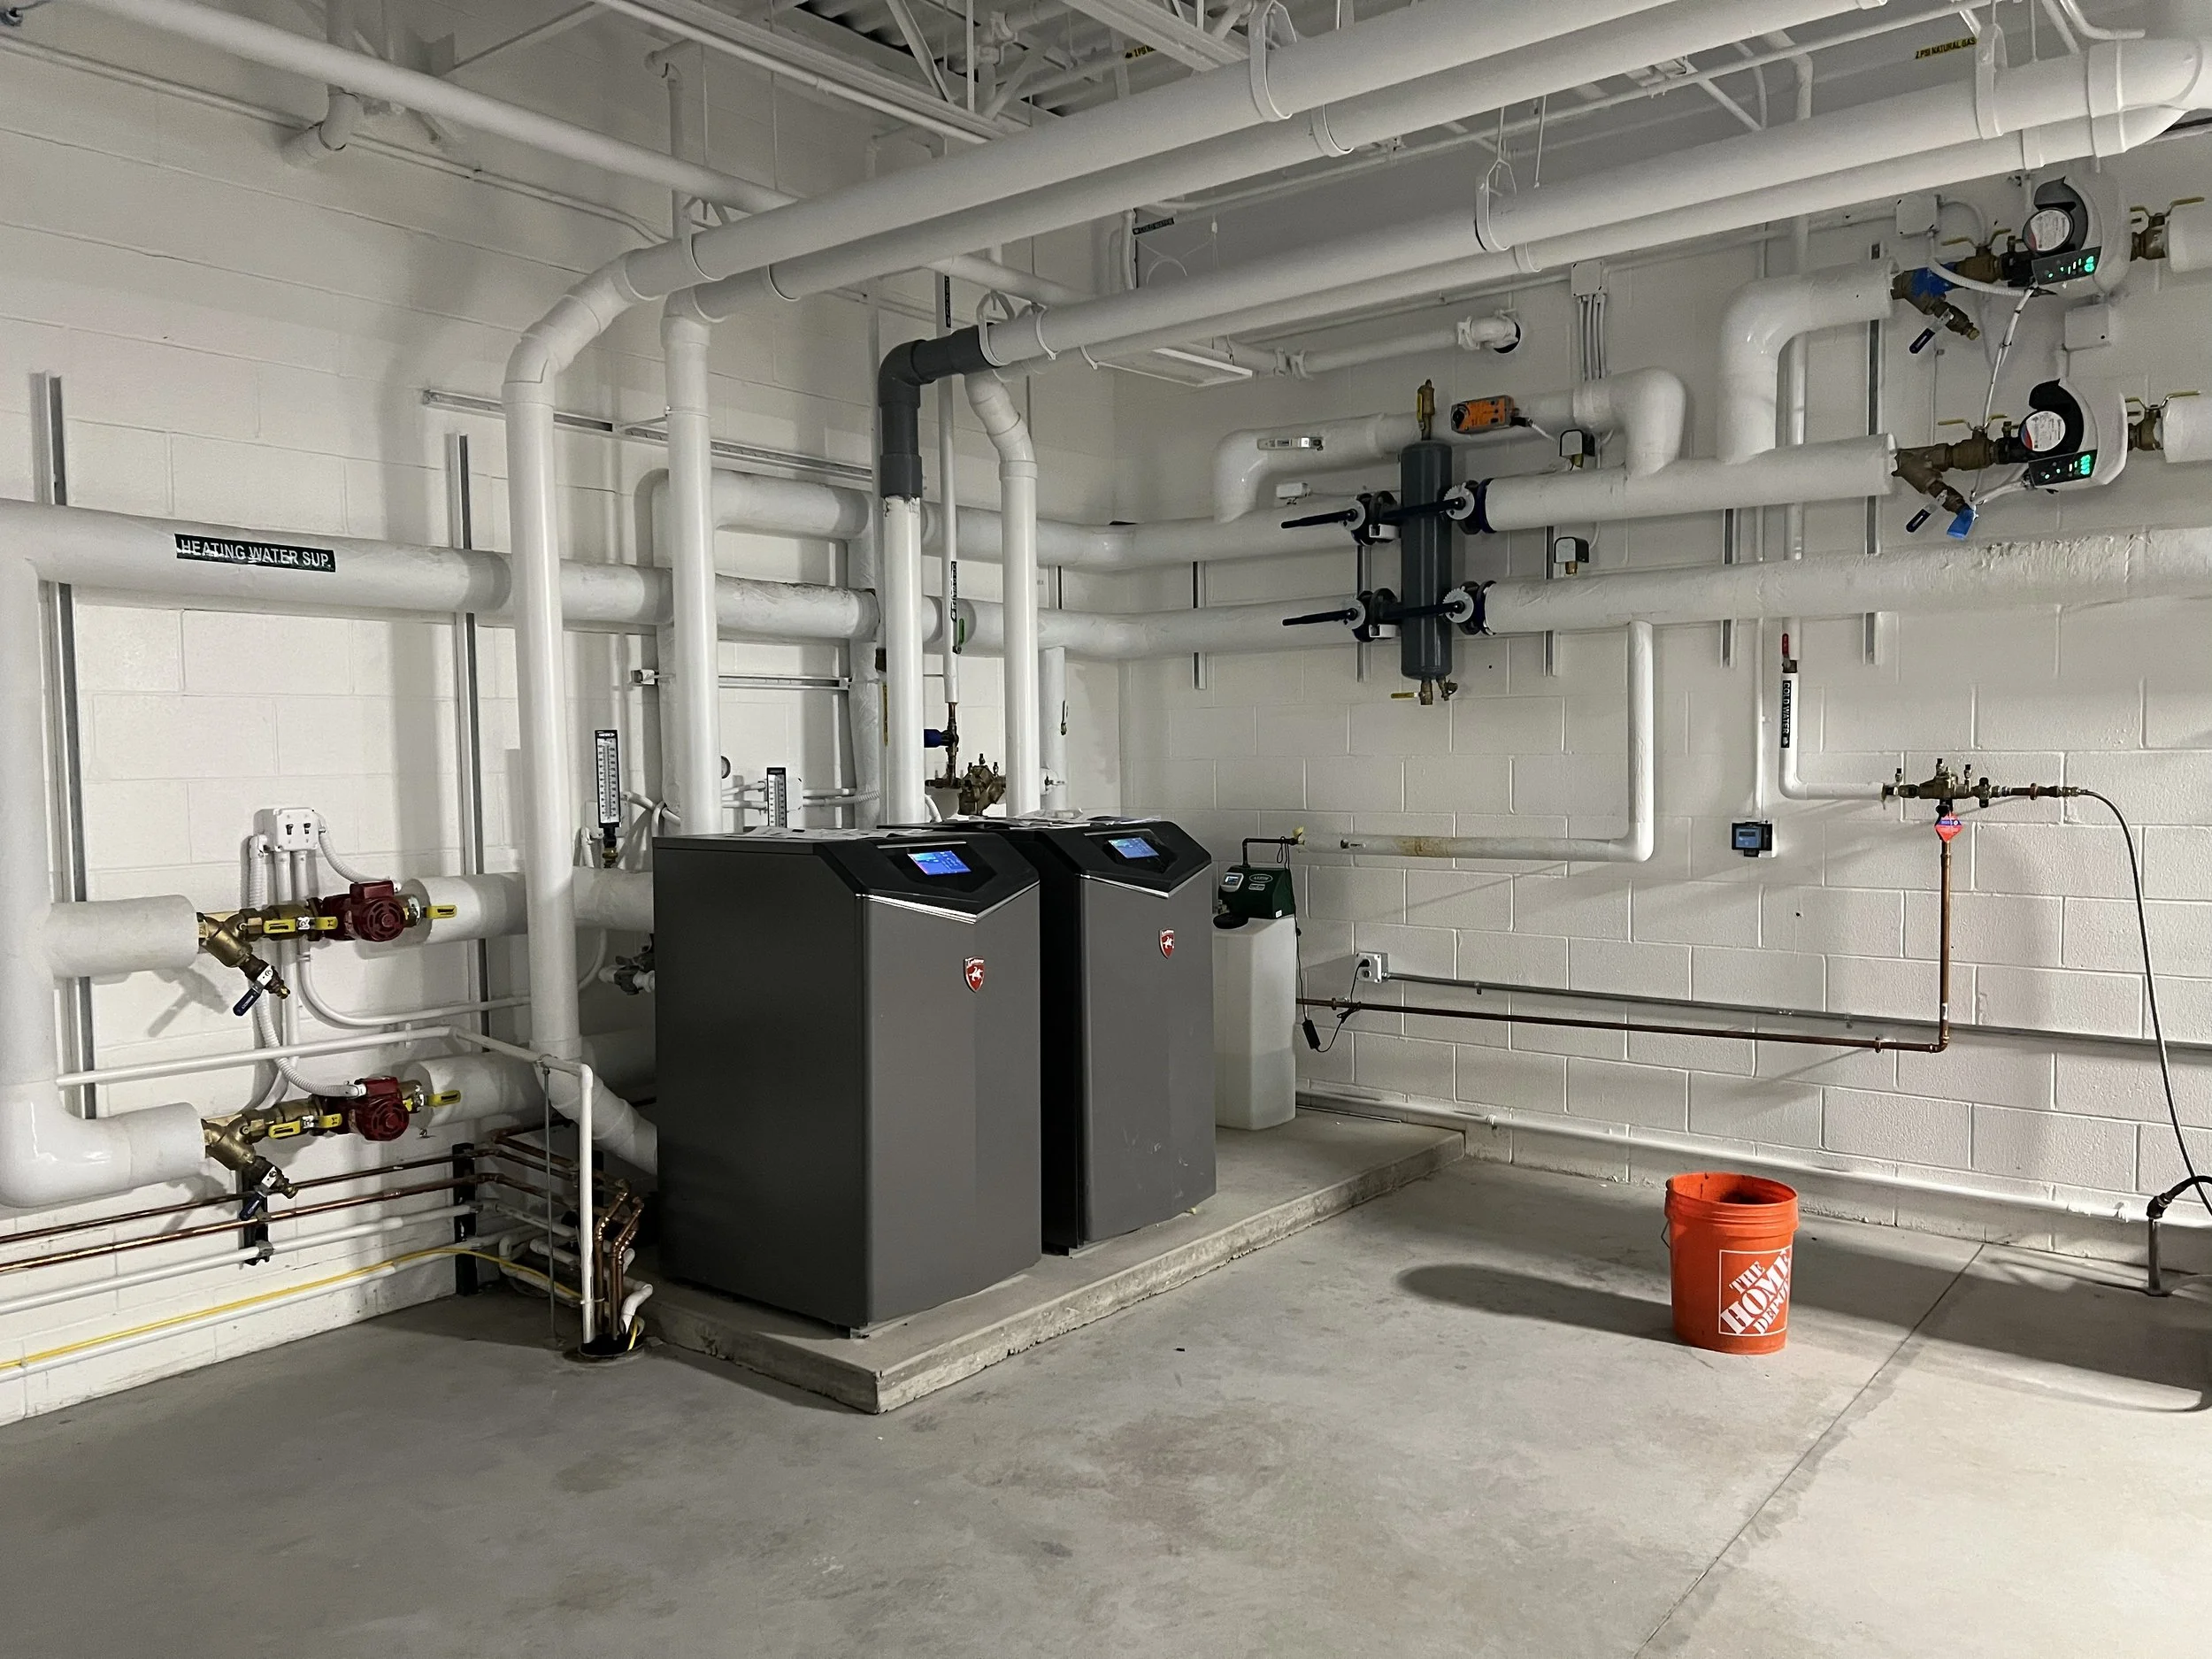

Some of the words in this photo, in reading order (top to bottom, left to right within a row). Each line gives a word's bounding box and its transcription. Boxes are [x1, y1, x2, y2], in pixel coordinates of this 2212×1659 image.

[1932, 41, 1962, 55] NATURAL
[1962, 36, 1977, 48] GAS
[180, 539, 246, 559] HEATING
[248, 545, 299, 565] WATER
[302, 550, 332, 568] SUP.
[1720, 1248, 1789, 1334] HOME
[1728, 1260, 1766, 1294] THE
